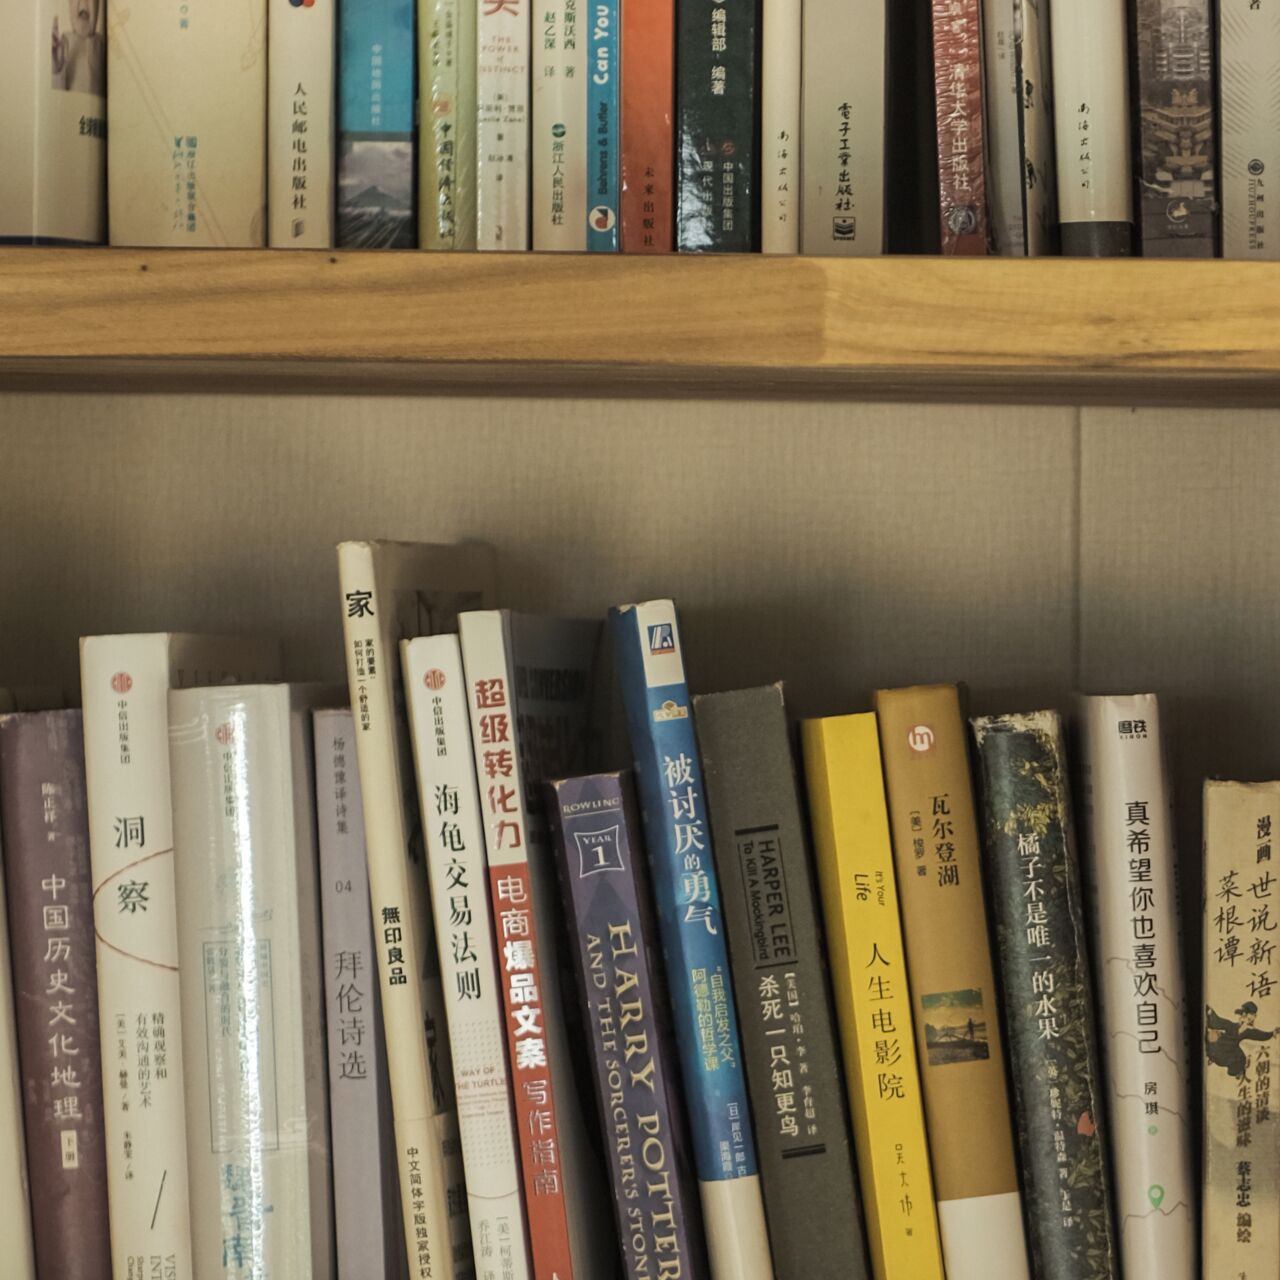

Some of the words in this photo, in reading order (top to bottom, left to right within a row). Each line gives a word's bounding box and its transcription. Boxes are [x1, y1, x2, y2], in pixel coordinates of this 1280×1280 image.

[593, 5, 609, 42] You
[593, 48, 609, 85] Can
[292, 82, 307, 210] 人民邮电出版社
[552, 141, 564, 226] 浙江人民出版社
[346, 590, 375, 618] 家
[474, 677, 523, 851] 超级转化力
[562, 796, 620, 814] ROWLING
[112, 815, 150, 915] 洞察
[582, 834, 612, 845] YEAR
[663, 752, 719, 936] 被讨厌的勇气
[743, 839, 754, 855] To
[745, 859, 758, 876] Kill
[749, 879, 759, 889] A
[759, 839, 784, 917] HARPER
[928, 793, 960, 888] 瓦尔登湖
[335, 879, 352, 894] 04
[432, 782, 483, 1002] 海龟交易法则
[750, 890, 769, 961] Mockingbird
[1123, 800, 1162, 1055] 真希望你也喜欢自己
[1213, 871, 1245, 969] 菜根谭
[381, 906, 408, 986] 無印良品
[587, 933, 608, 989] AND
[771, 922, 791, 958] LEE
[1015, 831, 1061, 1041] 橘子不是唯一的水果
[1246, 871, 1279, 1000] 世说新语
[41, 874, 83, 1121] 中国历史文化地理
[334, 949, 368, 1082] 拜伦诗选
[597, 1002, 619, 1052] THE
[608, 919, 655, 1093] HARRY
[865, 942, 906, 1102] 人生电影院
[759, 974, 799, 1137] 杀死一只知更鸟
[605, 1059, 640, 1200] SORCERER'S
